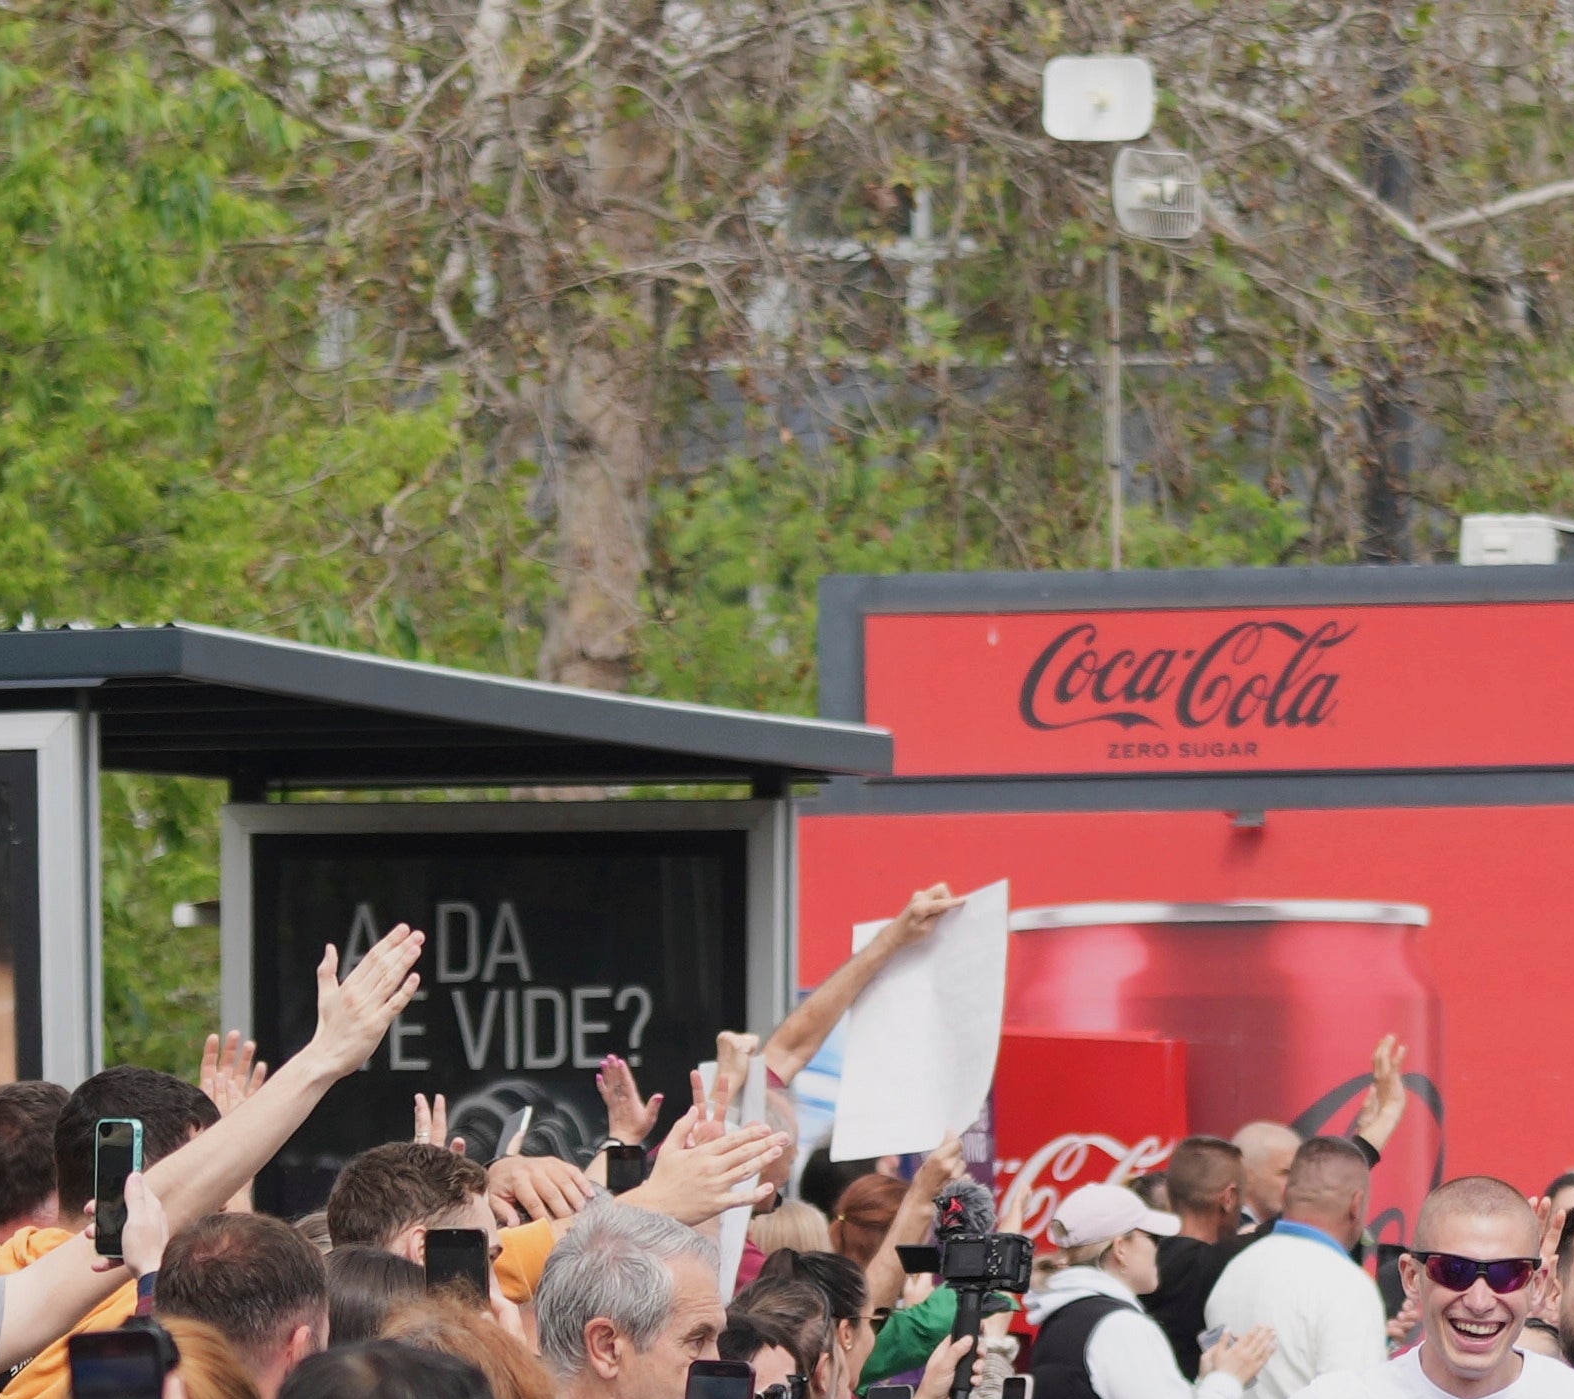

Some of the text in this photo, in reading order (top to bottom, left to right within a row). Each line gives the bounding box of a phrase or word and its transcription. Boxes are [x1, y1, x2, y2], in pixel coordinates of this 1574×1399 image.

[1019, 621, 1358, 732] Coca-Cola
[1108, 741, 1259, 759] ZERO SUGAR
[436, 902, 533, 983] DA
[451, 986, 654, 1071] VIDE?
